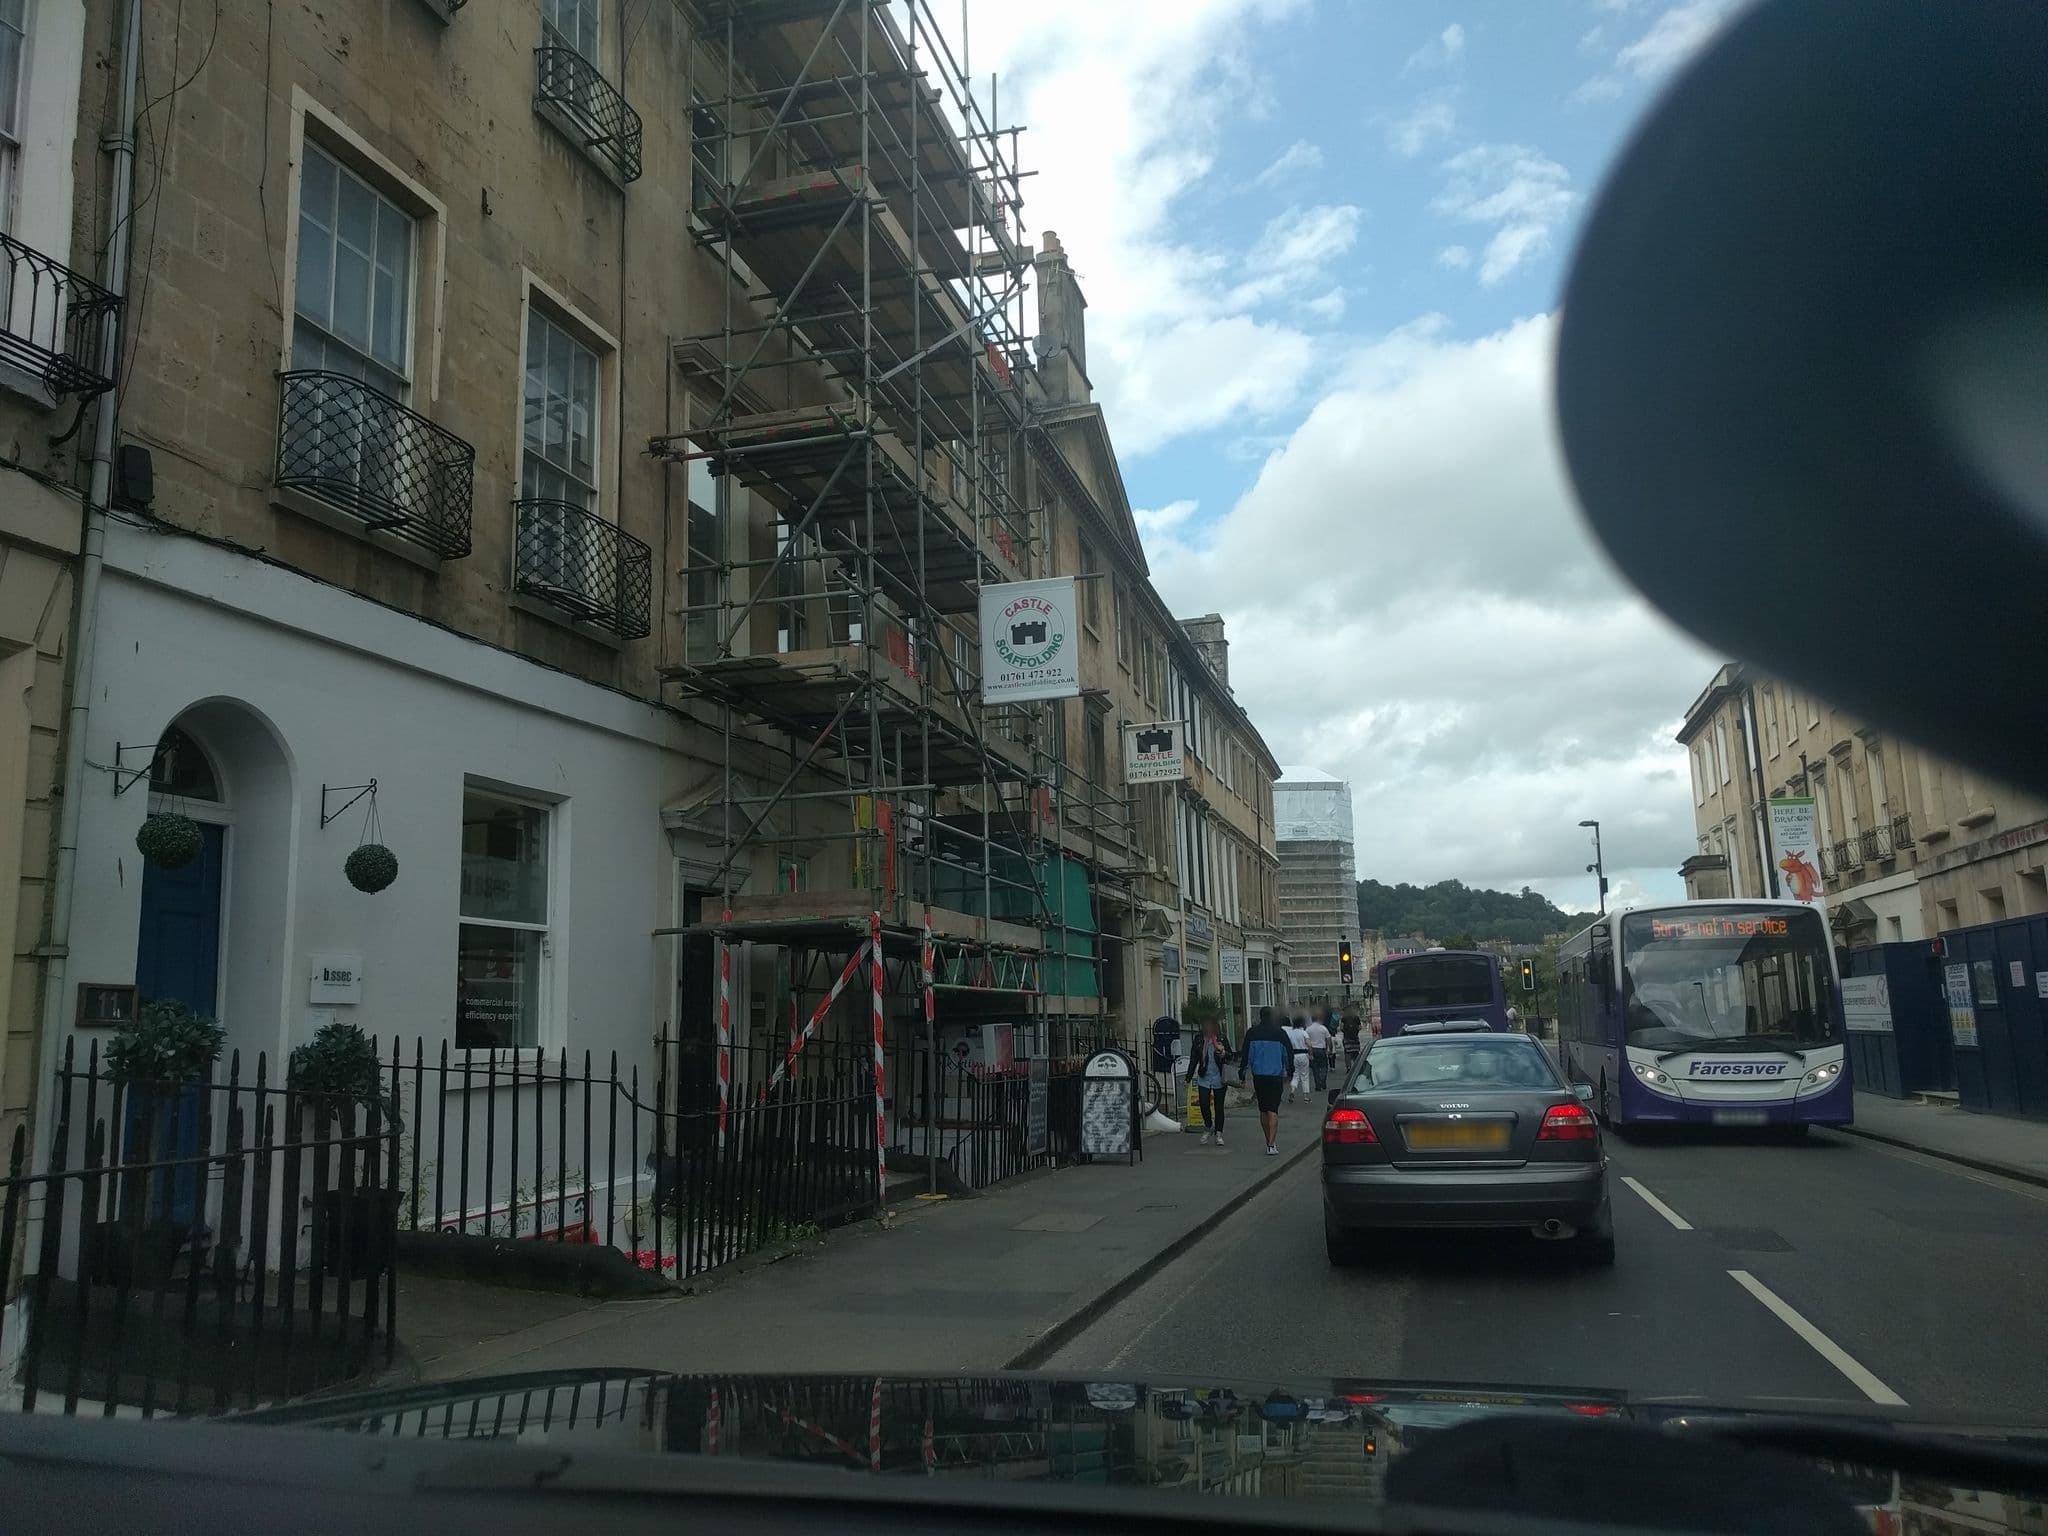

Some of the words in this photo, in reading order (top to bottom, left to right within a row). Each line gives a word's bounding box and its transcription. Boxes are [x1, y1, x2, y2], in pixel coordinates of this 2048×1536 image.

[1005, 598, 1053, 618] CASTLE
[996, 633, 1063, 668] SCAFFOLDING
[1000, 672, 1025, 682] 01761
[1028, 670, 1045, 679] 472
[1046, 668, 1062, 677] 922
[987, 676, 1075, 690] www.castlescaffolding.co.uk
[1136, 752, 1174, 761] CASTLE
[1129, 759, 1182, 769] SCAFFOLDING
[1129, 771, 1151, 779] 01761
[1154, 768, 1182, 777] 472922
[1696, 917, 1720, 936] not
[1722, 918, 1734, 936] in
[1737, 917, 1787, 936] service
[465, 997, 503, 1007] commercial
[465, 1010, 496, 1021] efficiency
[1689, 1061, 1786, 1076] Faresaver
